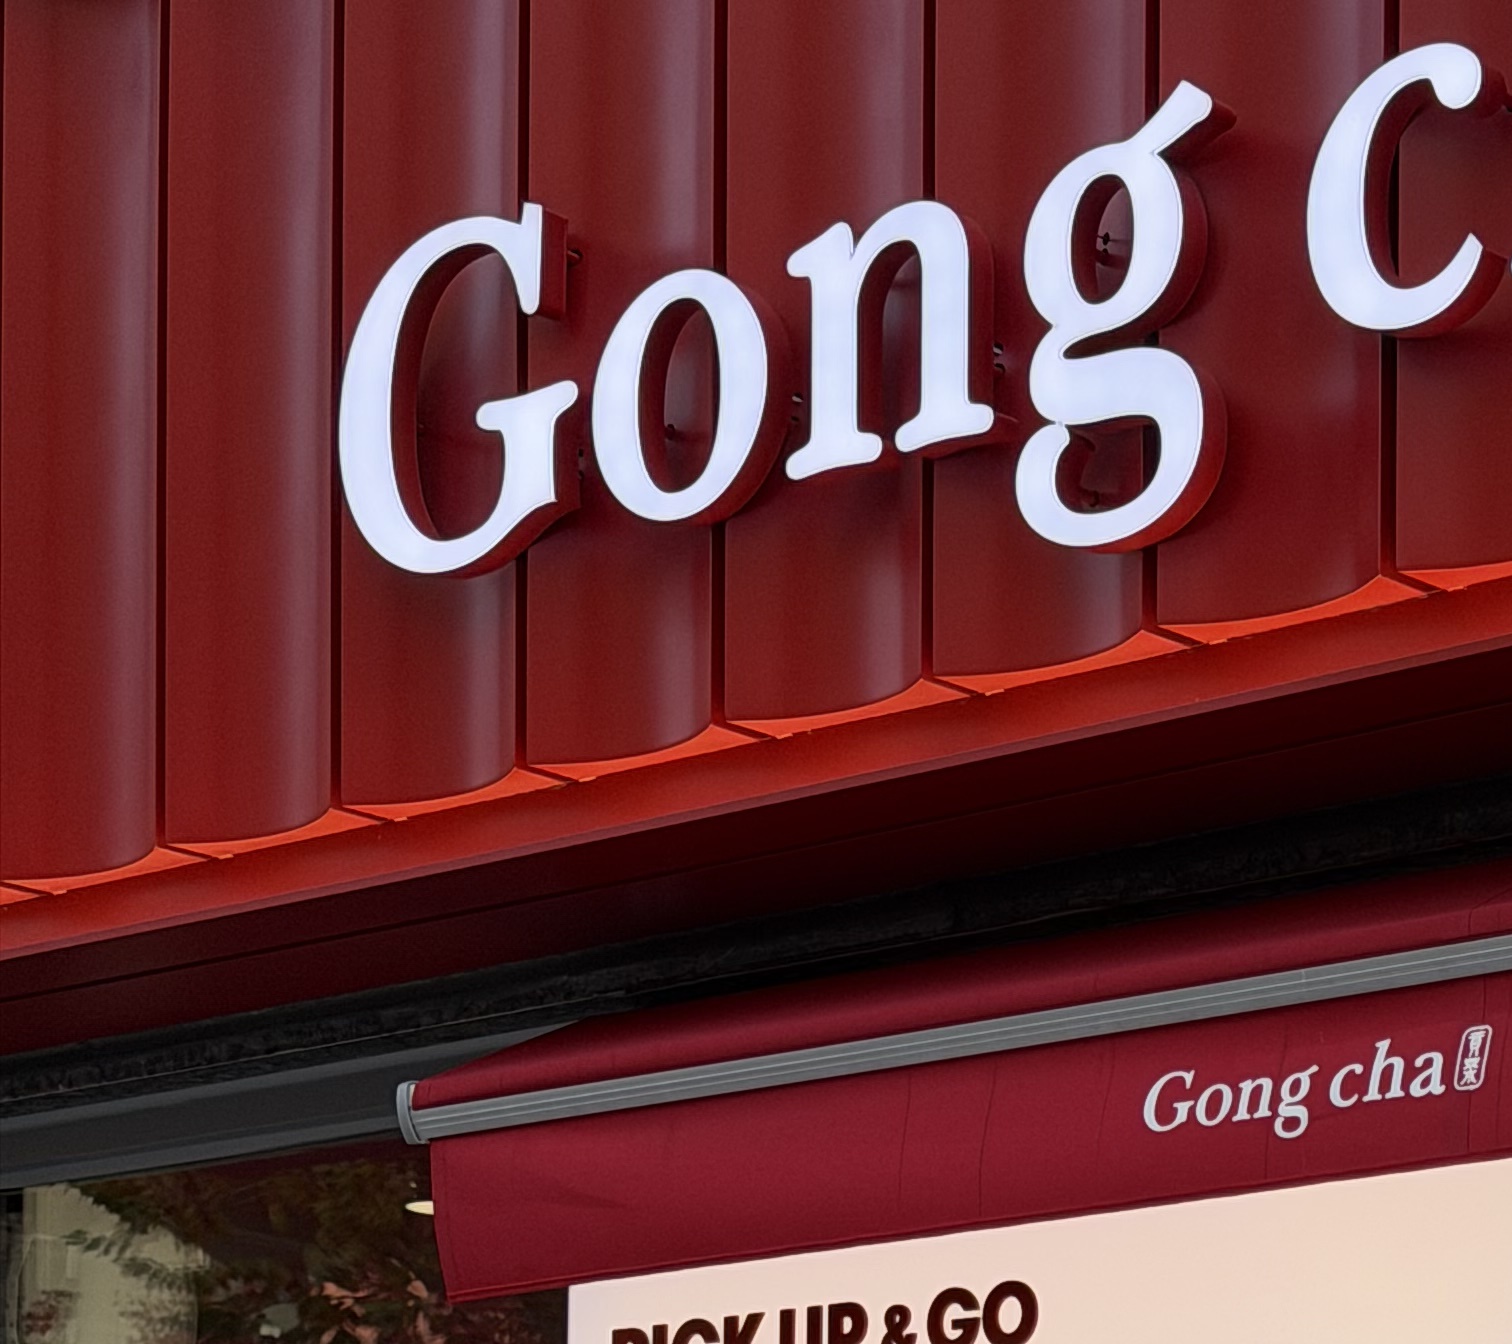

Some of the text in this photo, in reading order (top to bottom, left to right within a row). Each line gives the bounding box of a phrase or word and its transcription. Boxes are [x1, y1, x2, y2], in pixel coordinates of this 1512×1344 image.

[338, 79, 1213, 576] Gong
[1143, 1038, 1446, 1139] Gong cha
